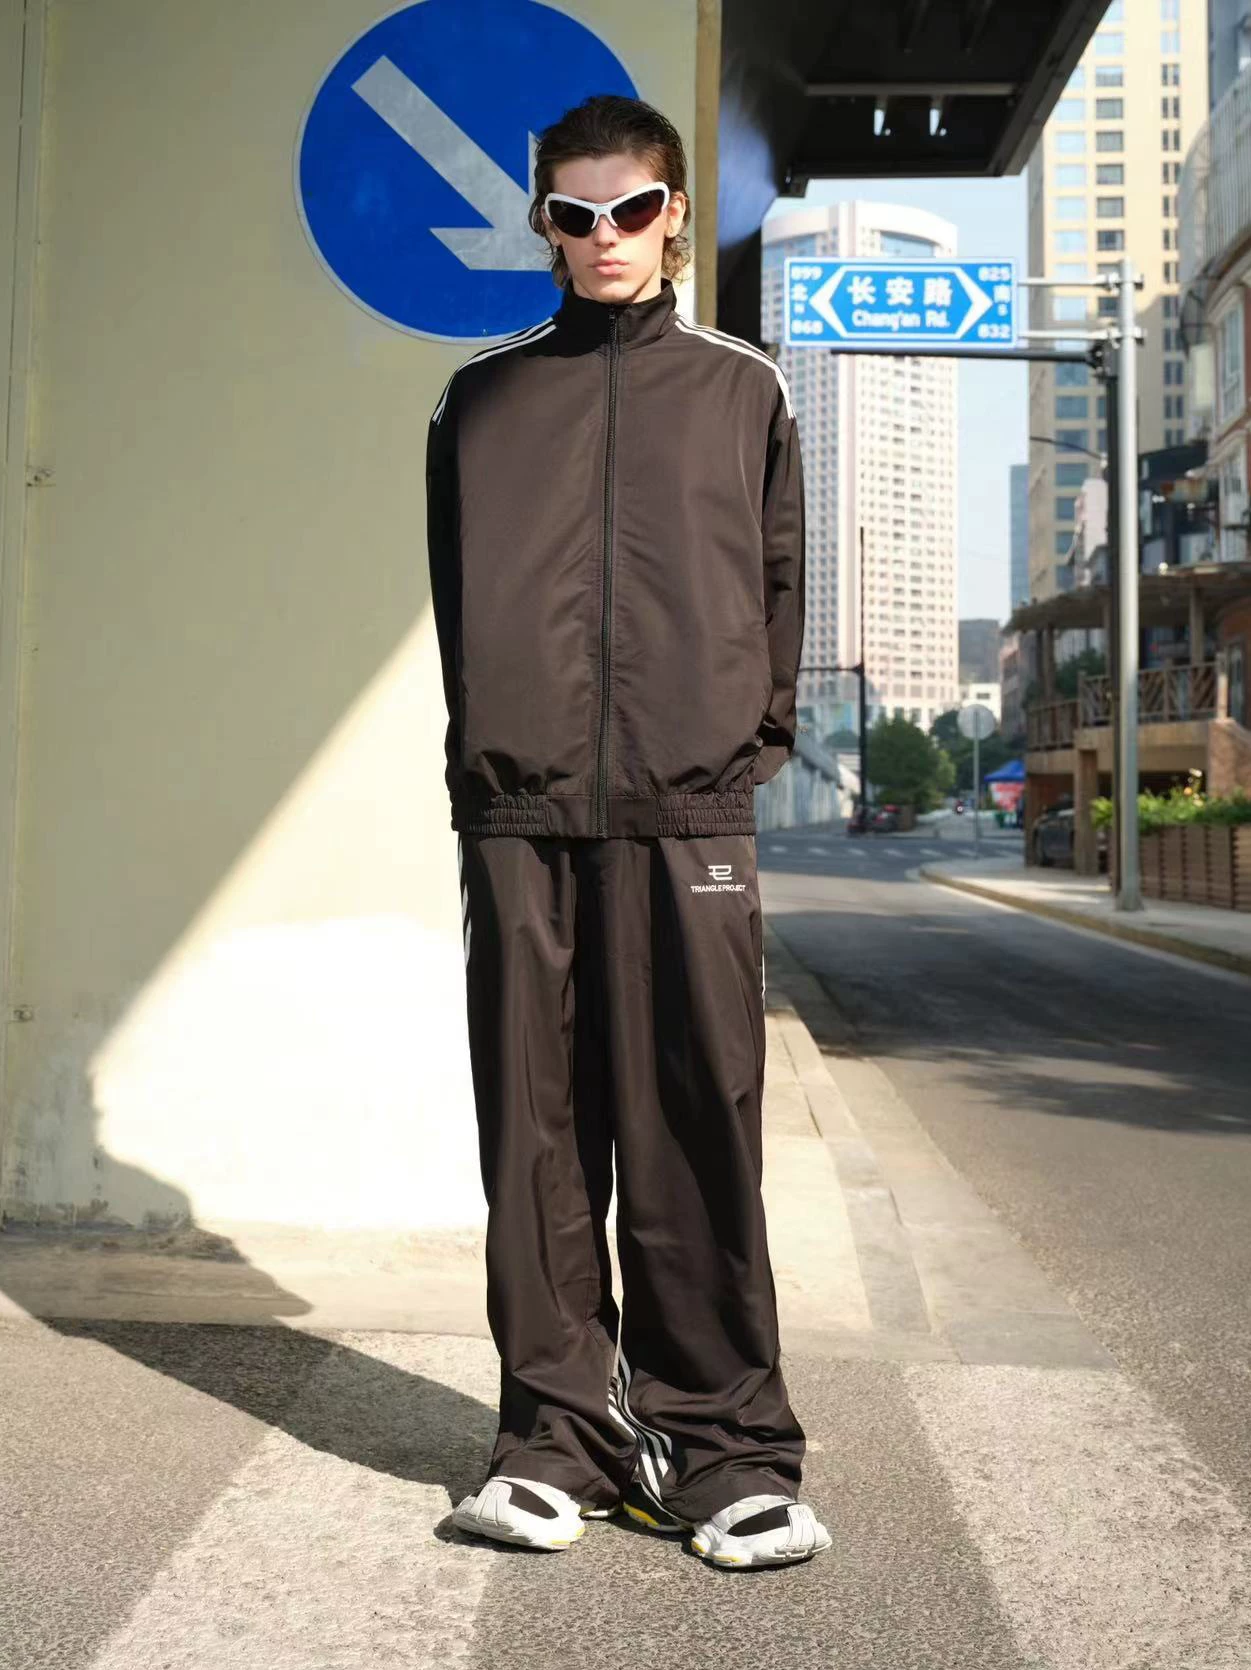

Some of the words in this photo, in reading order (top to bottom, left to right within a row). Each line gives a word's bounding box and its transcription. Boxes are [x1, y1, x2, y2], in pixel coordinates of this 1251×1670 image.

[847, 276, 952, 306] 长安路
[852, 310, 921, 331] Chang'an
[925, 310, 950, 327] Rd.
